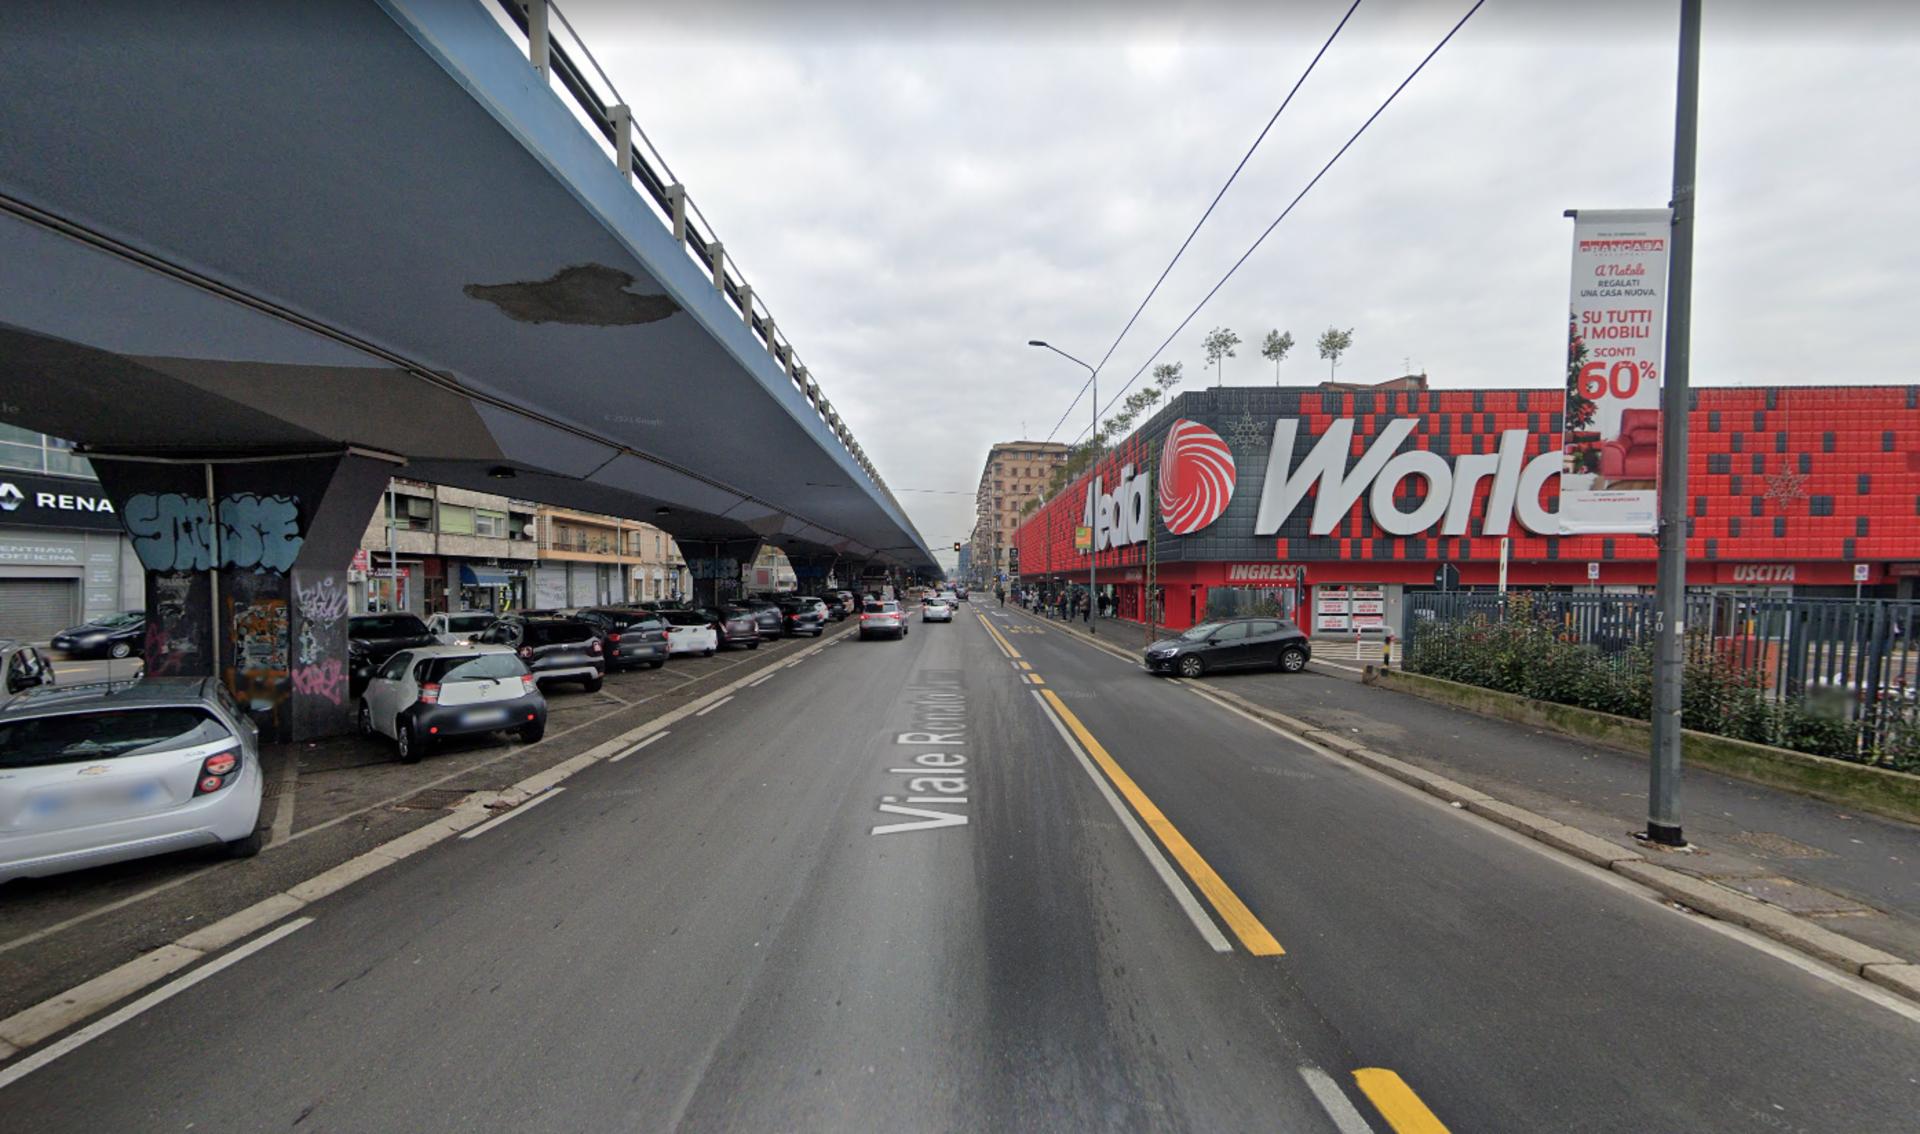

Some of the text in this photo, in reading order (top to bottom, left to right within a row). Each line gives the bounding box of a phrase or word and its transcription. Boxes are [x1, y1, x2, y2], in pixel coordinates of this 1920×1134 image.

[1580, 240, 1664, 252] GRANCASA
[1608, 263, 1645, 276] Natale
[1598, 280, 1640, 288] REGALATI
[1580, 289, 1598, 297] UNA
[1600, 288, 1622, 297] CASA
[1582, 309, 1652, 324] SU TUTTI
[1583, 325, 1650, 340] I MOBILI
[1594, 347, 1636, 357] SCONTI
[1577, 360, 1657, 400] 60%
[36, 492, 115, 514] RENA
[1081, 462, 1149, 554] Media
[0, 546, 74, 554] ENTRATA
[1733, 565, 1795, 581] USCITA
